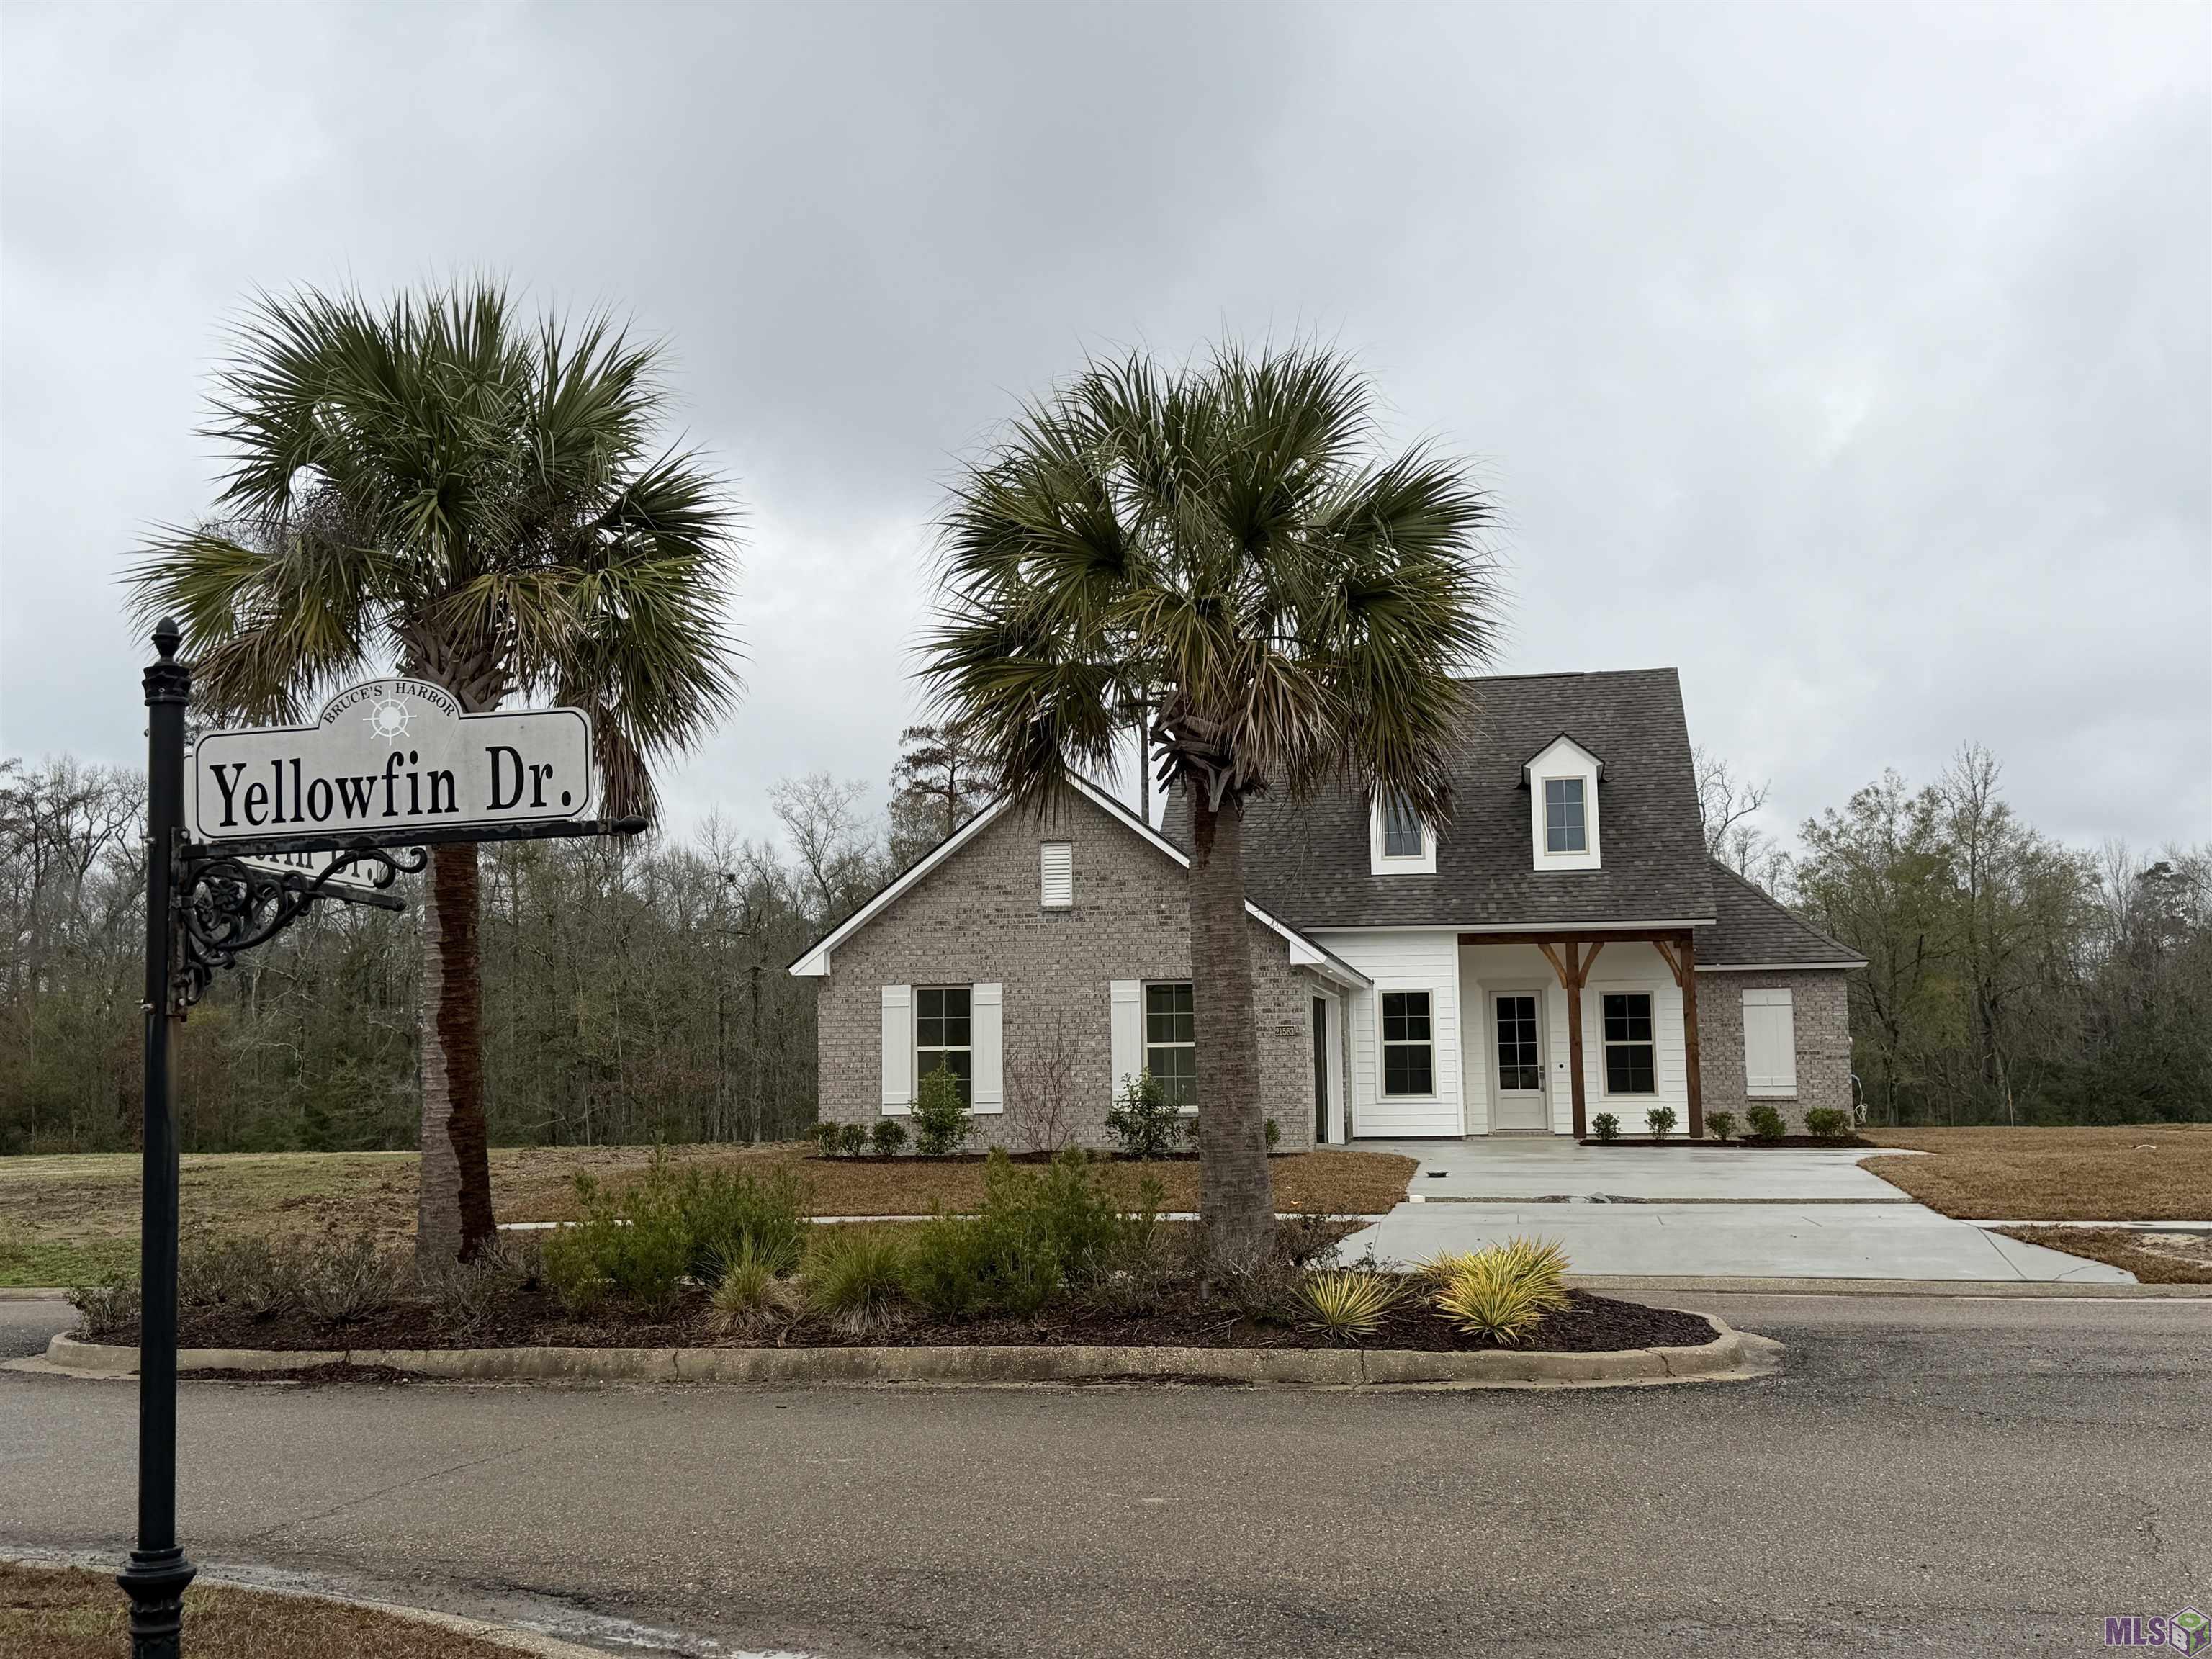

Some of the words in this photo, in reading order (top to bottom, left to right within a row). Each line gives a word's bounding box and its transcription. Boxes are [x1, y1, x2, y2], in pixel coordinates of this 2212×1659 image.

[323, 685, 382, 725] BRUCE'S
[395, 682, 456, 717] HARBOR
[209, 750, 459, 827] Yellowfin
[485, 745, 572, 811] Dr.
